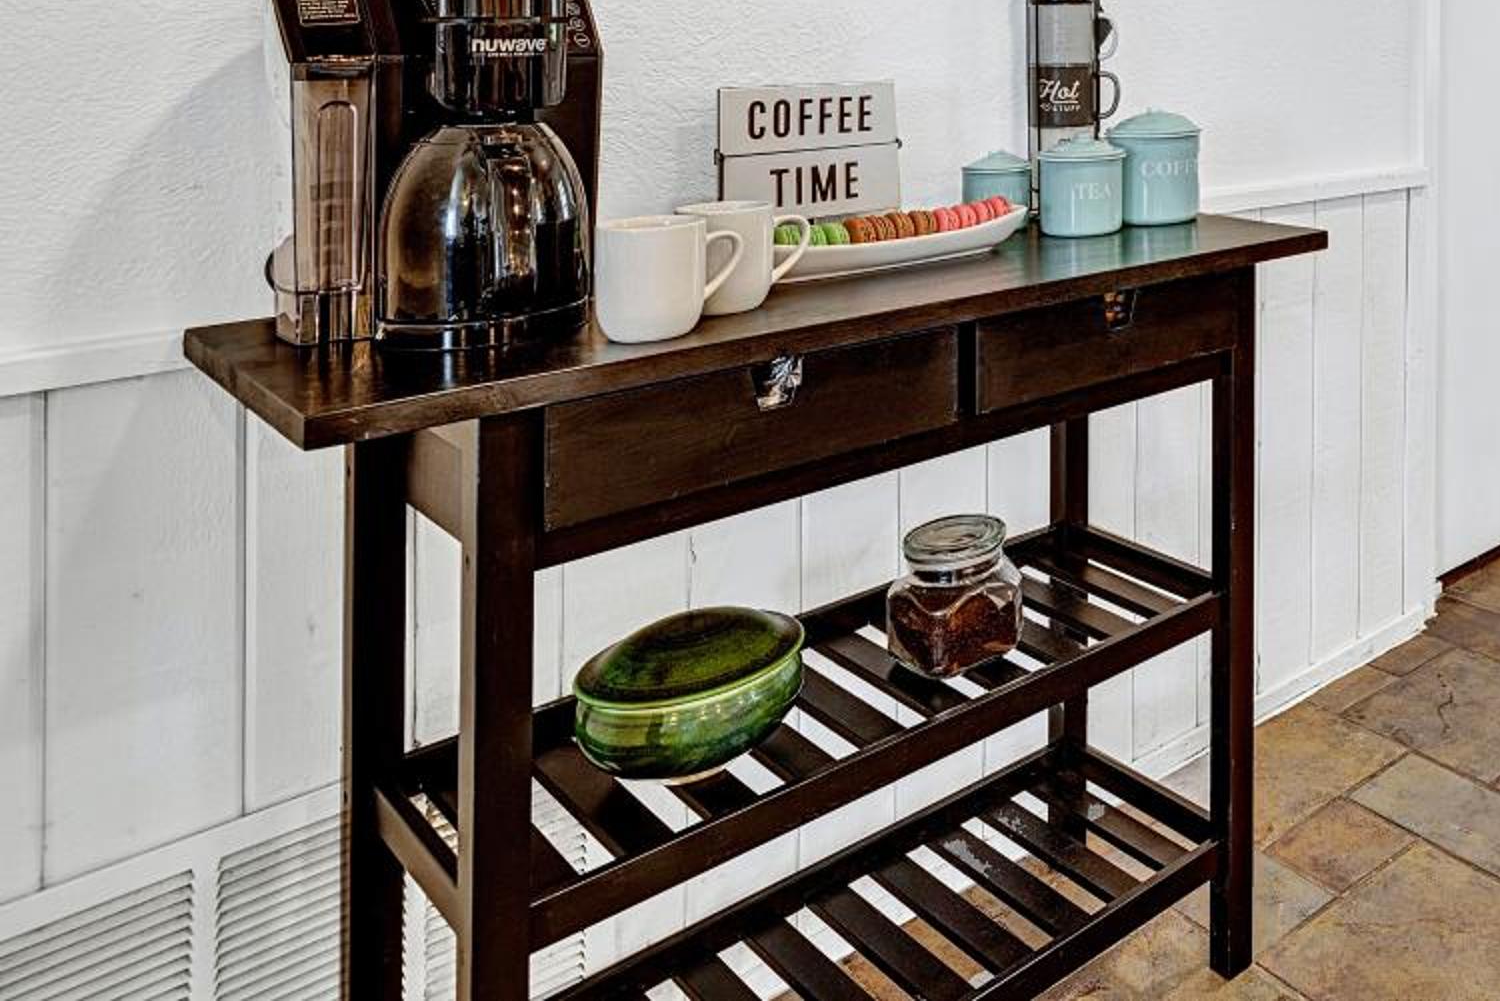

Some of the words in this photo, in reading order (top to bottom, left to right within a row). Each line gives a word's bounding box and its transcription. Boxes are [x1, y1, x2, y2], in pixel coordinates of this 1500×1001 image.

[471, 38, 546, 52] nuwave
[1039, 79, 1080, 104] Hot
[748, 95, 872, 139] COFFEE
[769, 162, 858, 207] TIME
[1072, 182, 1114, 200] TEA
